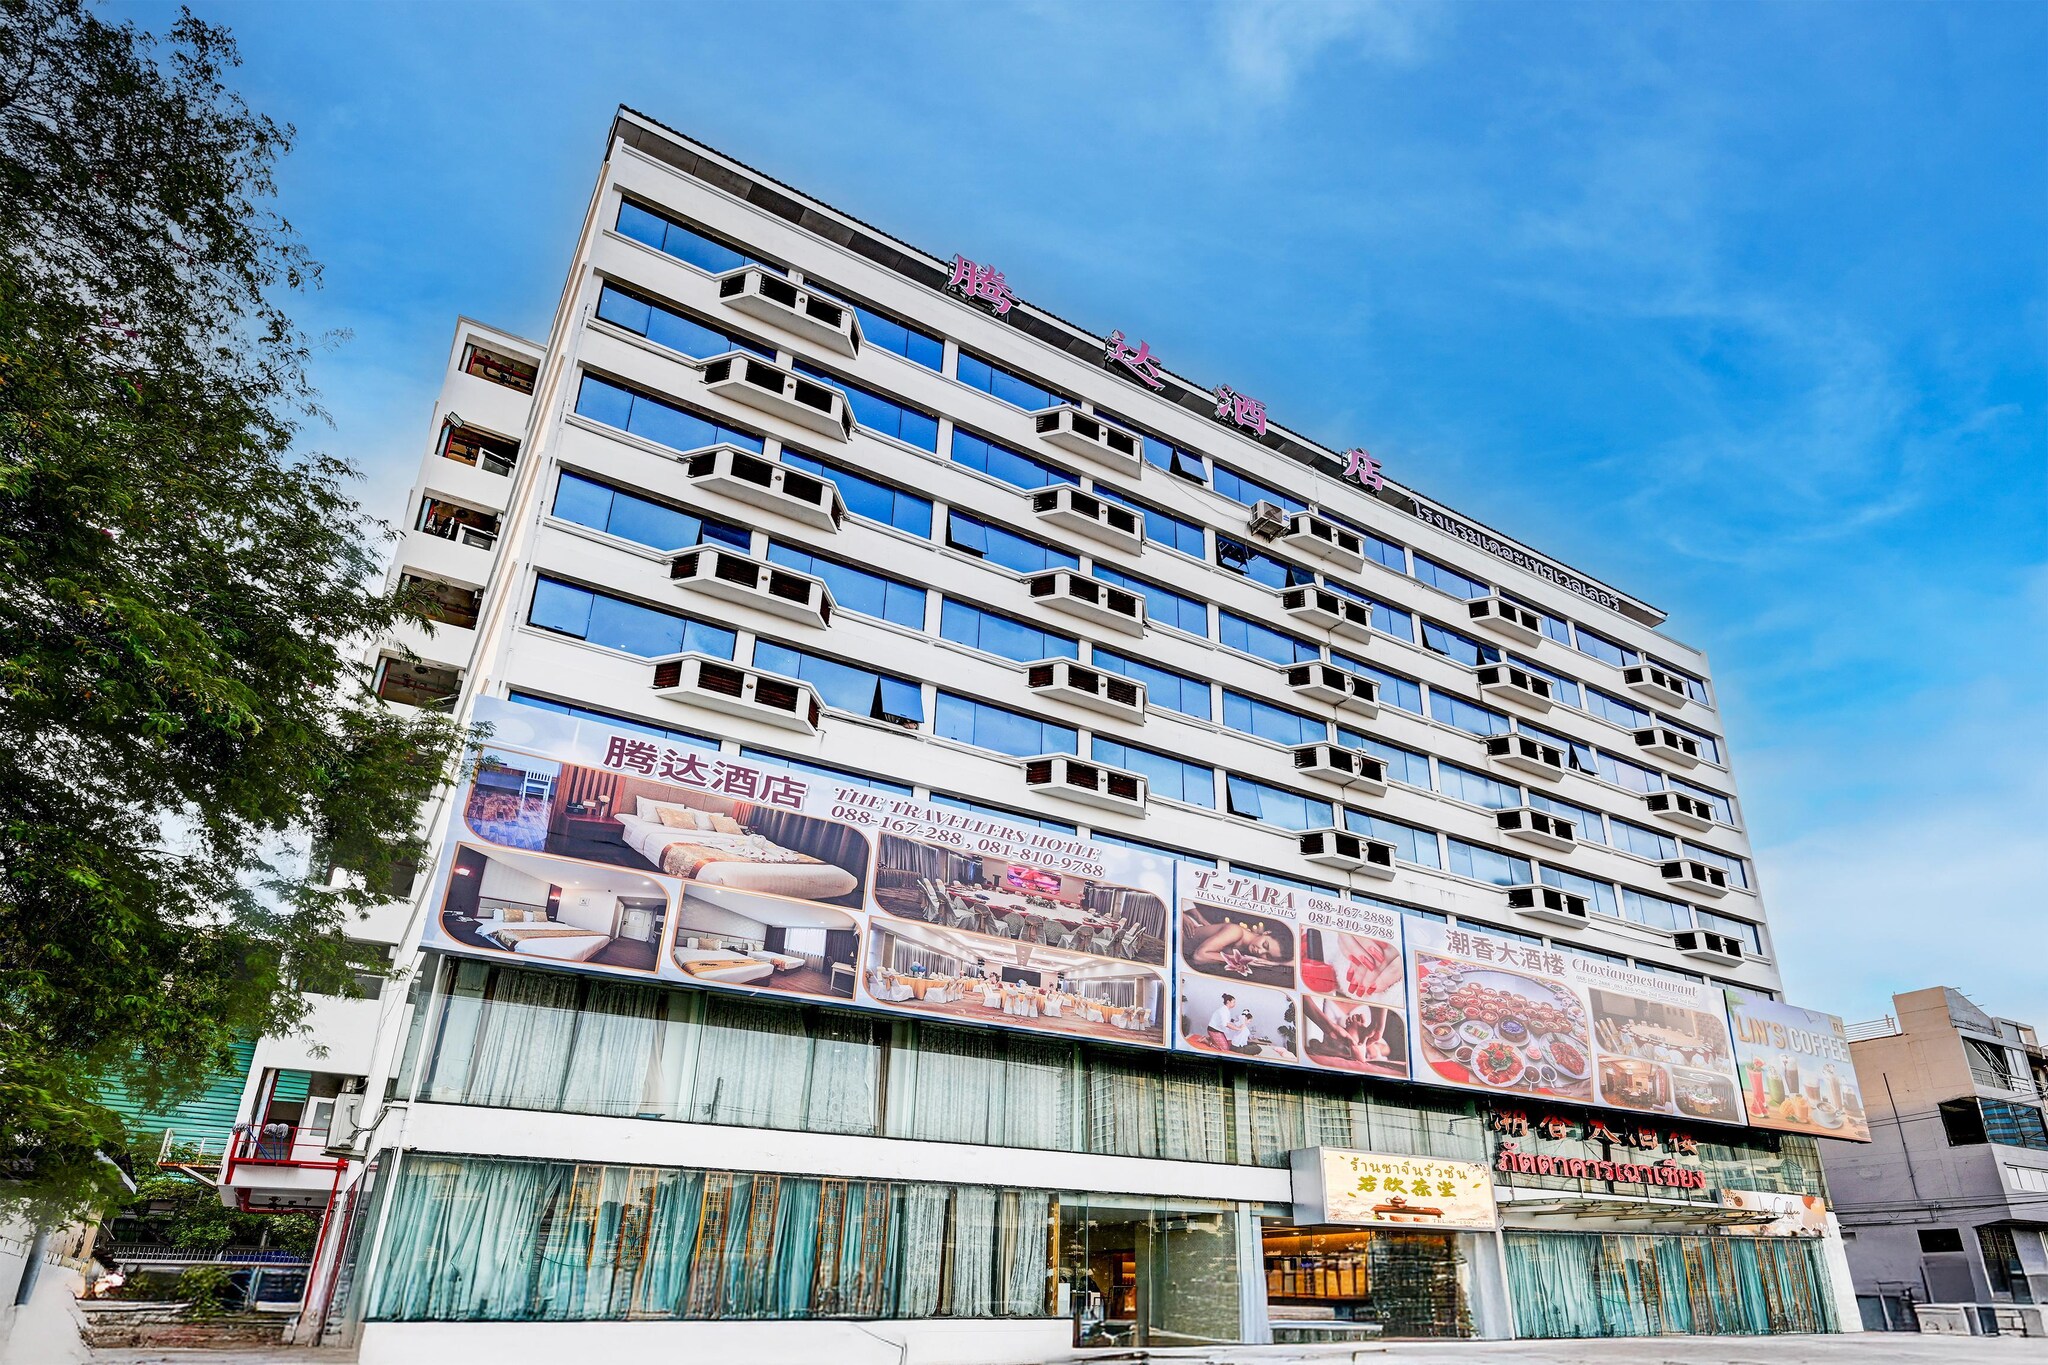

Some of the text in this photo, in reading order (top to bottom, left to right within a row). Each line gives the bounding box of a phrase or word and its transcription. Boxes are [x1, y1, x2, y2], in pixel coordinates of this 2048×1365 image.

[604, 735, 809, 810] 腾达酒店
[831, 804, 963, 846] 088-167-288
[977, 838, 1105, 878] 081-810-9788
[835, 787, 1101, 861] THE TRAVELLERS HOTLE
[1194, 870, 1296, 911] T-TARA
[1308, 898, 1394, 926] 088-167-2888
[1308, 911, 1395, 939] 081-810-9788
[1445, 928, 1566, 977] 潮香大酒楼
[1734, 1013, 1850, 1063] LIN'S COFFEE
